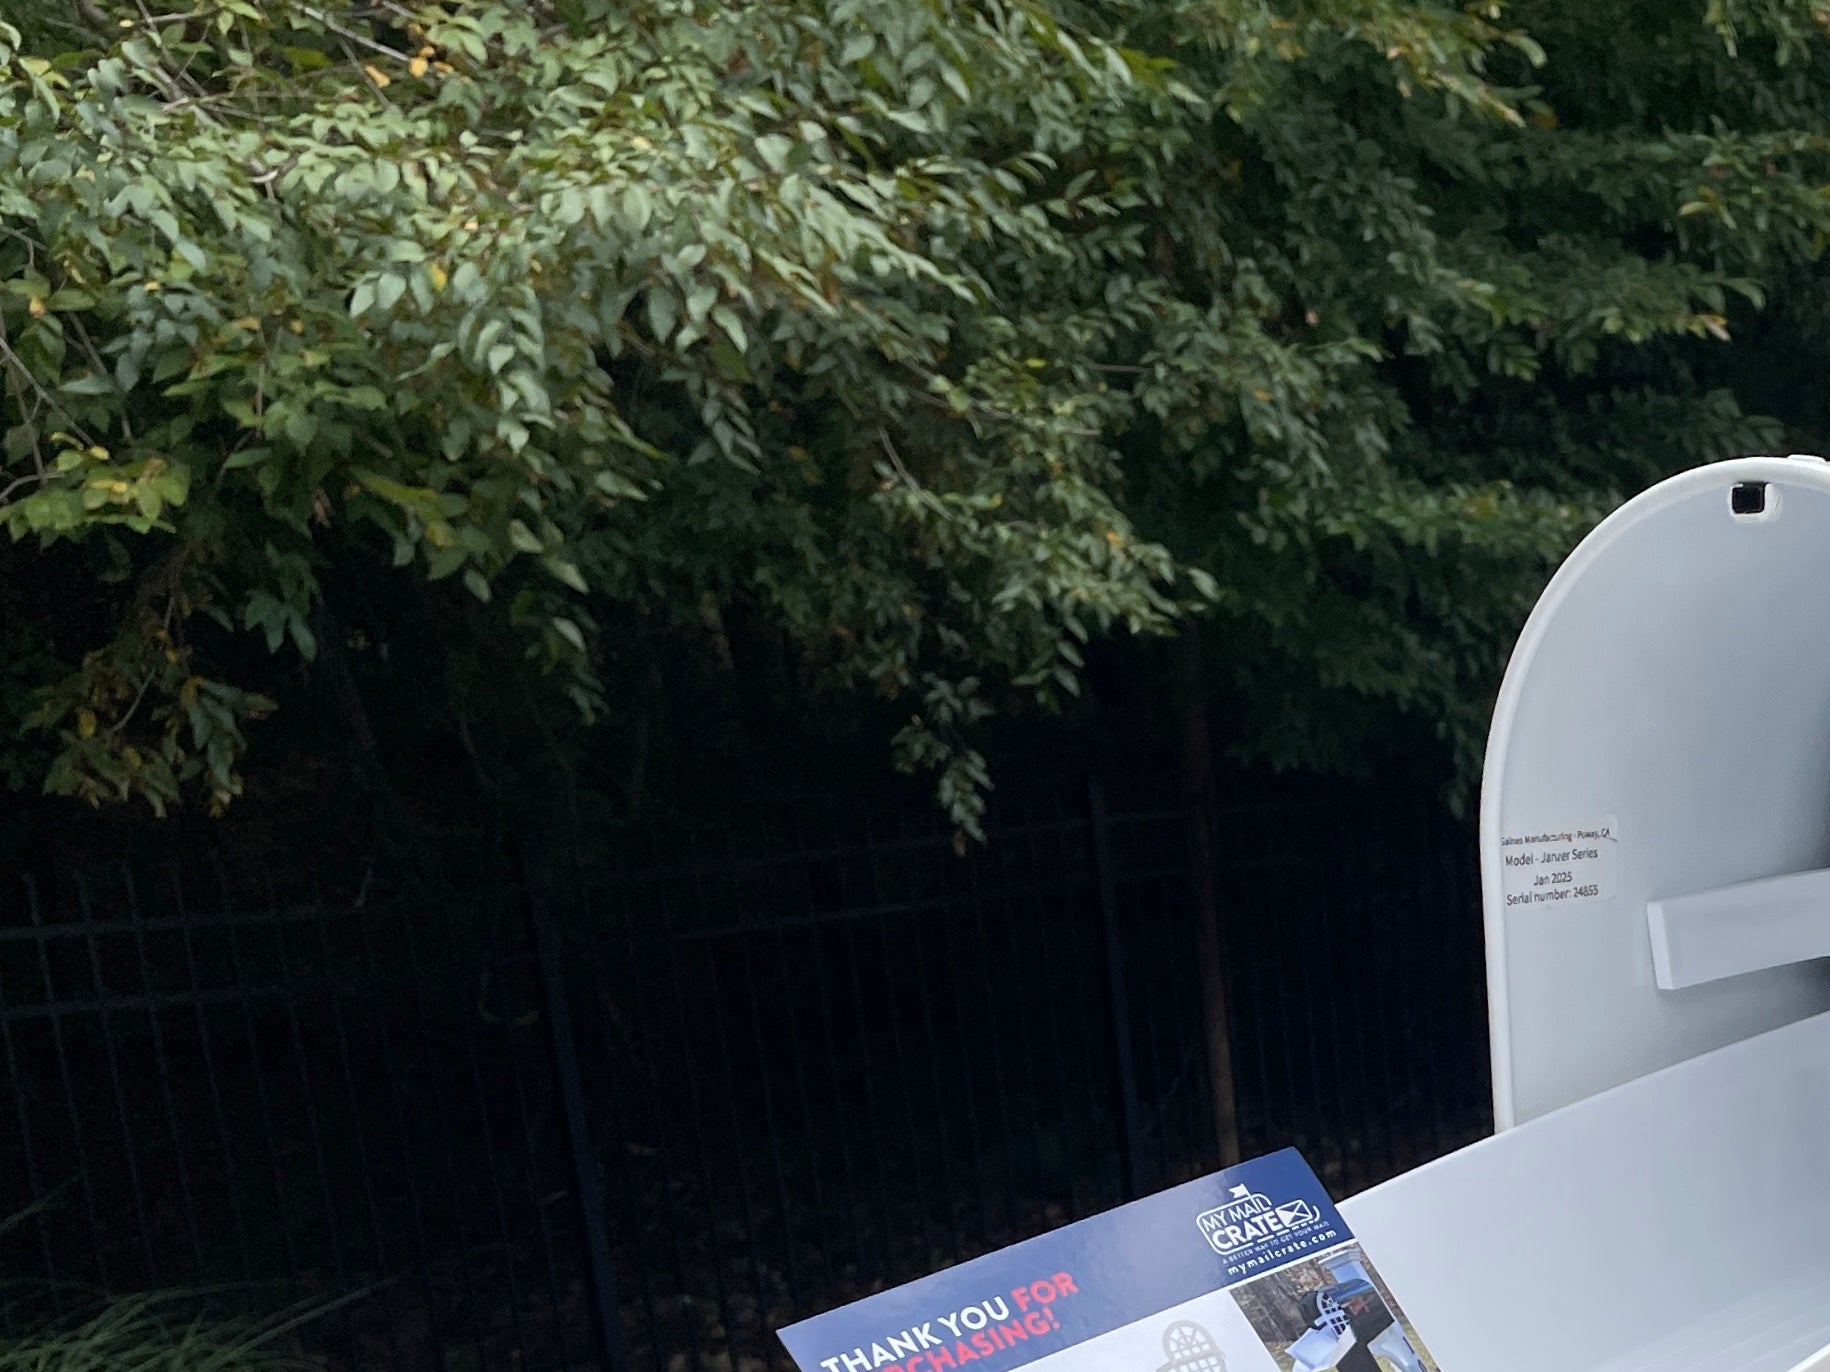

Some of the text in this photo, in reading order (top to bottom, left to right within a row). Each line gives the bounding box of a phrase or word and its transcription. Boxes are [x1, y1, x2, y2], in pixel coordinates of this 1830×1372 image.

[1505, 853, 1534, 866] Model
[1572, 848, 1598, 860] Series
[1533, 871, 1573, 886] Jan 2025
[1506, 891, 1532, 906] Serial
[1201, 1197, 1271, 1232] MY MAIL
[1211, 1210, 1283, 1250] CRATE
[1280, 1233, 1293, 1243] GET
[1227, 1229, 1337, 1276] mymailcrate.com
[936, 1295, 1010, 1337] YOU
[1010, 1271, 1079, 1312] FOR
